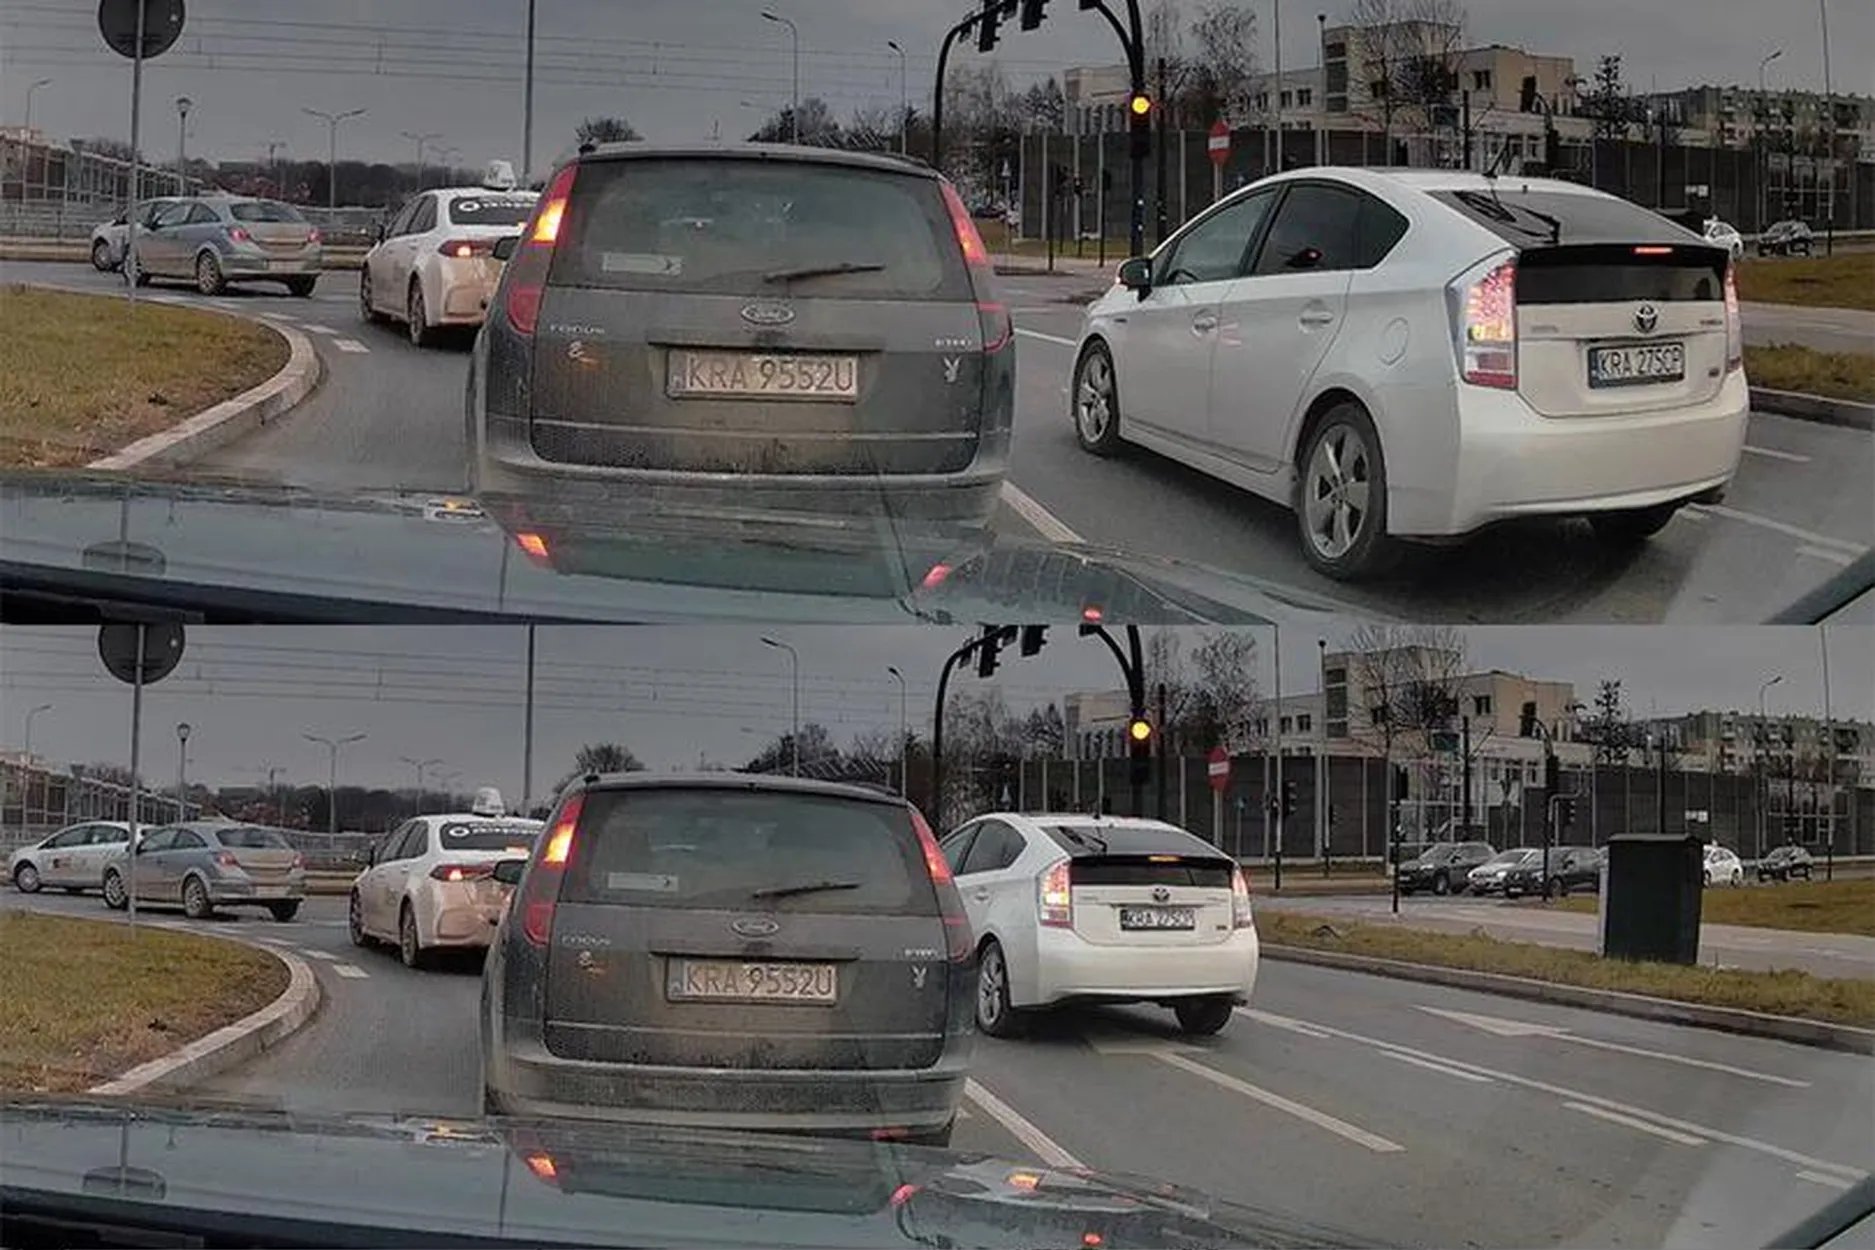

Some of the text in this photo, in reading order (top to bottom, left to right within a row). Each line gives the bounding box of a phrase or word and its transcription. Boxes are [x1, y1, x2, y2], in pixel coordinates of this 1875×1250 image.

[688, 353, 854, 392] KRA 9552U
[1599, 350, 1632, 378] KRA
[686, 963, 834, 997] KRA 9552U
